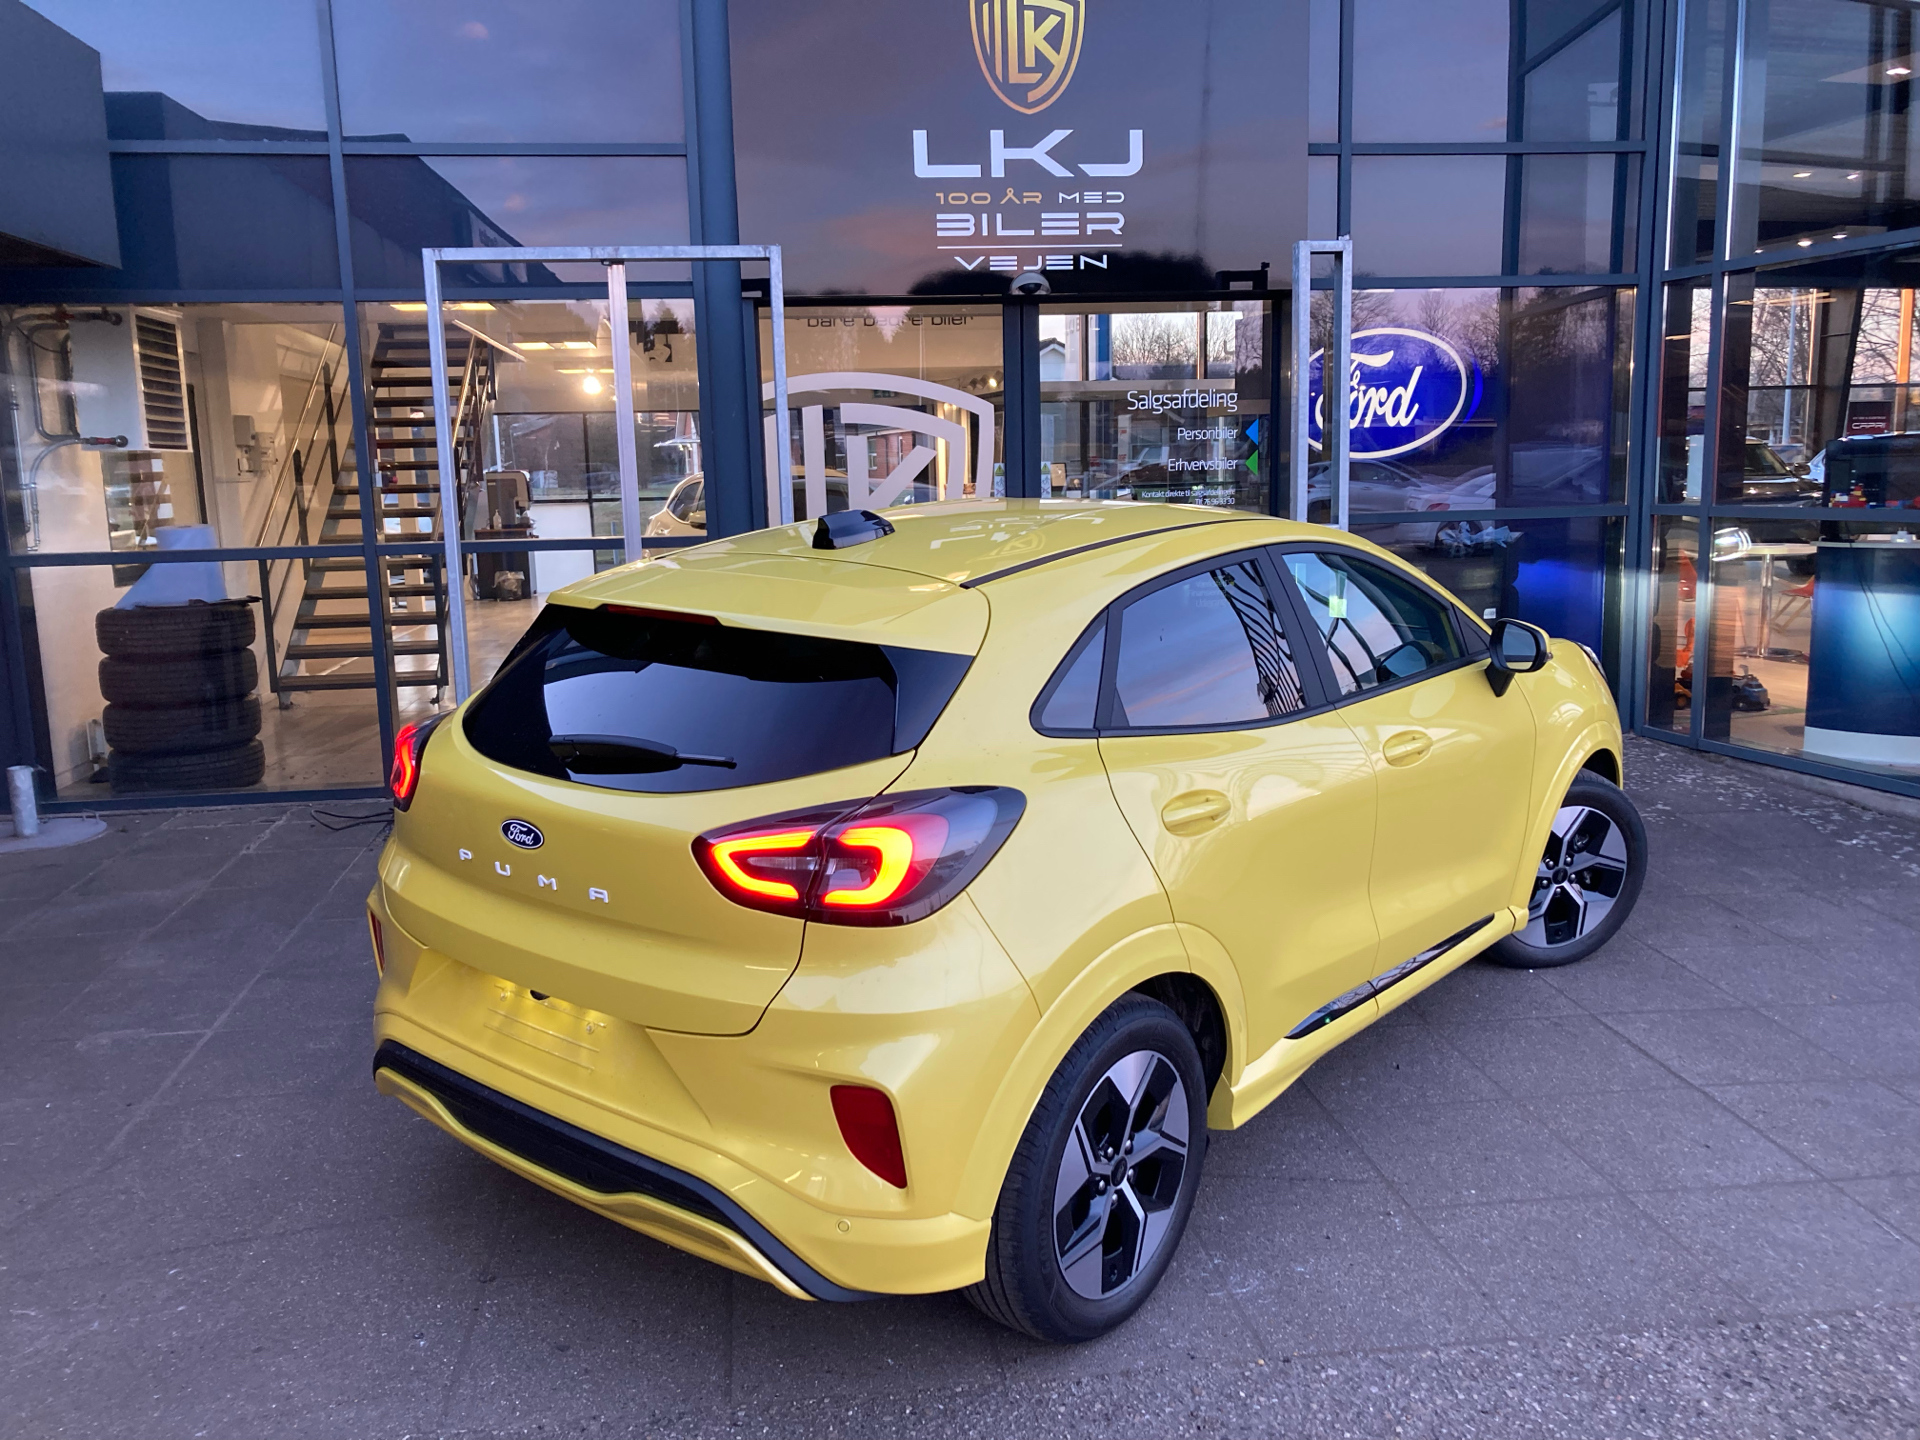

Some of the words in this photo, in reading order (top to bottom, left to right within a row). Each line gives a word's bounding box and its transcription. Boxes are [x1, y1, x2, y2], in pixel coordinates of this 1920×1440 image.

[912, 129, 1144, 178] LKJ
[936, 192, 991, 205] 100
[1000, 187, 1043, 205] ÅR
[1058, 191, 1125, 204] MED
[936, 212, 1125, 236] BILER
[953, 254, 1108, 271] VEJEN
[1127, 389, 1239, 414] Salgsafdeling
[1177, 427, 1238, 441] Personbiler
[1168, 458, 1238, 472] Erhvervsbiler
[1141, 490, 1165, 498] Kontakt
[1165, 489, 1184, 498] direkte
[508, 823, 535, 845] Ford
[458, 848, 609, 904] PUMA
